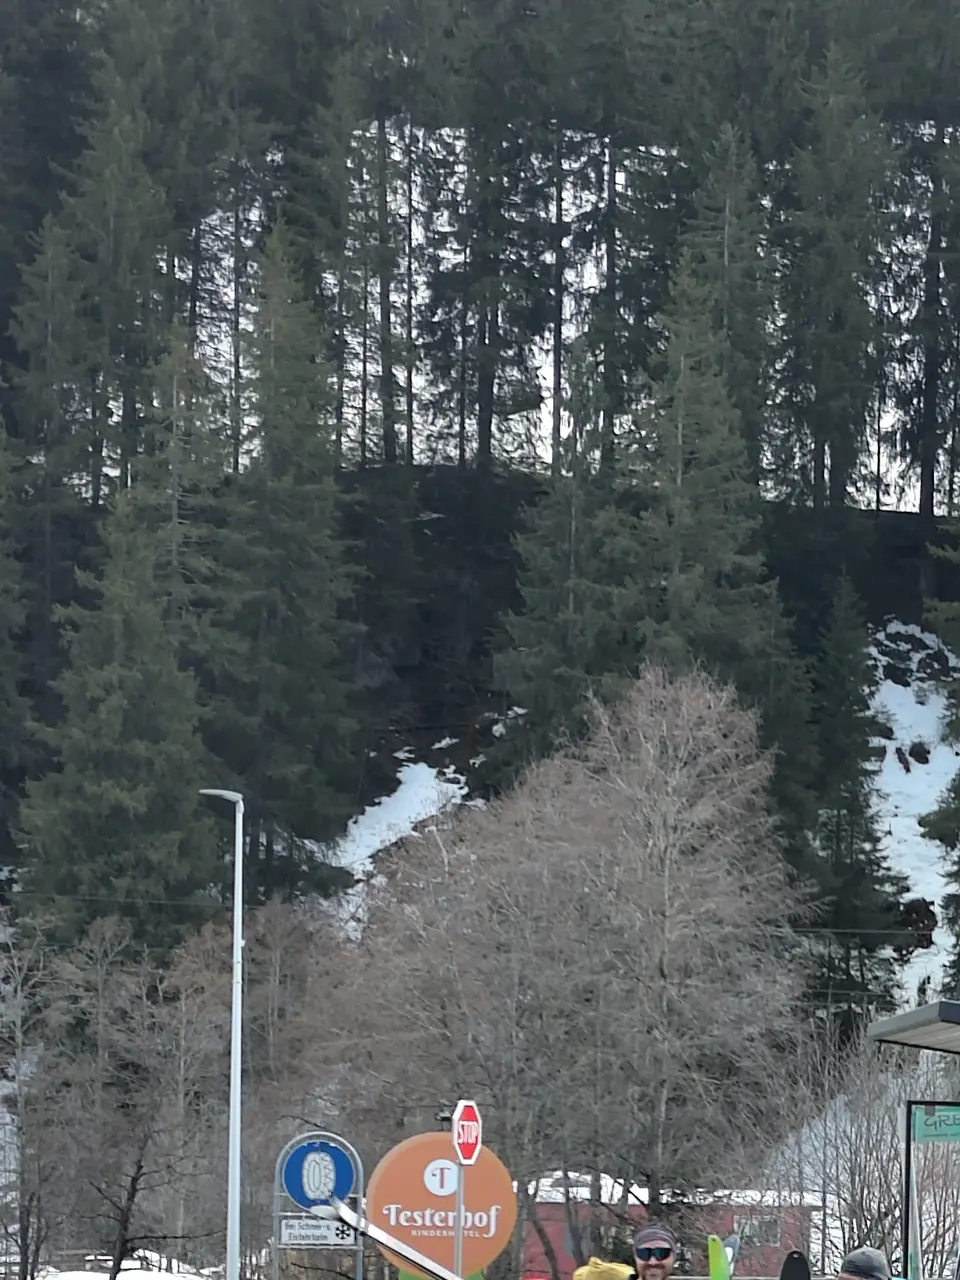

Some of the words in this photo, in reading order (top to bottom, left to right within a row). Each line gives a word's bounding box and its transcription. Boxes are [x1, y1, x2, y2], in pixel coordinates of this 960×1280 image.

[457, 1120, 479, 1145] STOP
[431, 1166, 452, 1189] T
[382, 1203, 502, 1238] Testerhof
[410, 1229, 480, 1238] KINDERHTEL
